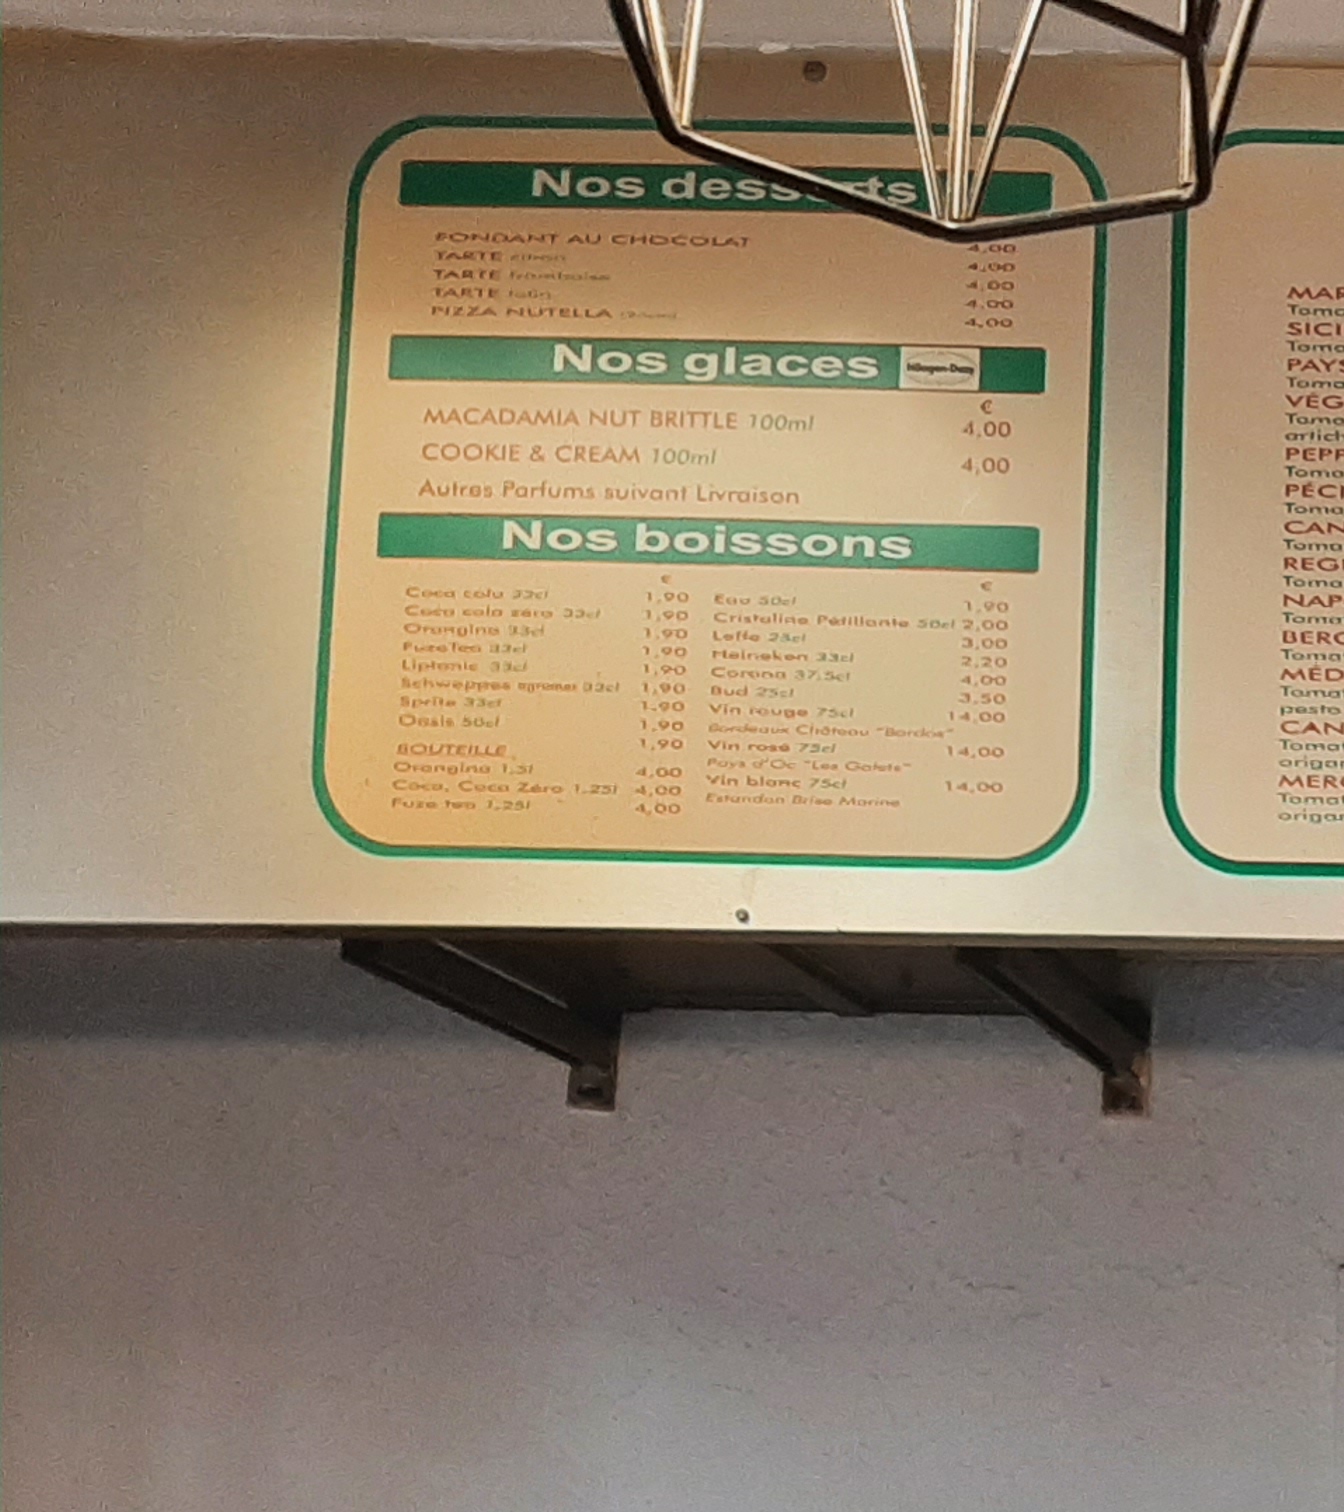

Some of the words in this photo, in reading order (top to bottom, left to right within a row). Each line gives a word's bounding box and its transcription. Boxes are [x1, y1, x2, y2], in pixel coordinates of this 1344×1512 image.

[532, 169, 645, 198] Nos
[553, 343, 668, 374] Nos
[684, 344, 879, 382] glaces
[423, 407, 580, 427] MACADAMIA
[588, 409, 642, 428] NUT
[650, 409, 738, 430] BRITTLE
[749, 413, 815, 432] 100ml
[962, 420, 1012, 439] 4,00
[421, 442, 521, 463] COOKIE
[529, 444, 546, 463] &
[554, 444, 641, 465] CREAM
[653, 447, 717, 466] 100ml
[960, 456, 1011, 476] 4,00
[417, 478, 494, 499] Autres
[502, 479, 596, 501] Parfums
[604, 482, 688, 502] suivant
[696, 483, 800, 505] Livraison
[502, 520, 618, 551] Nos
[635, 522, 912, 559] boissons
